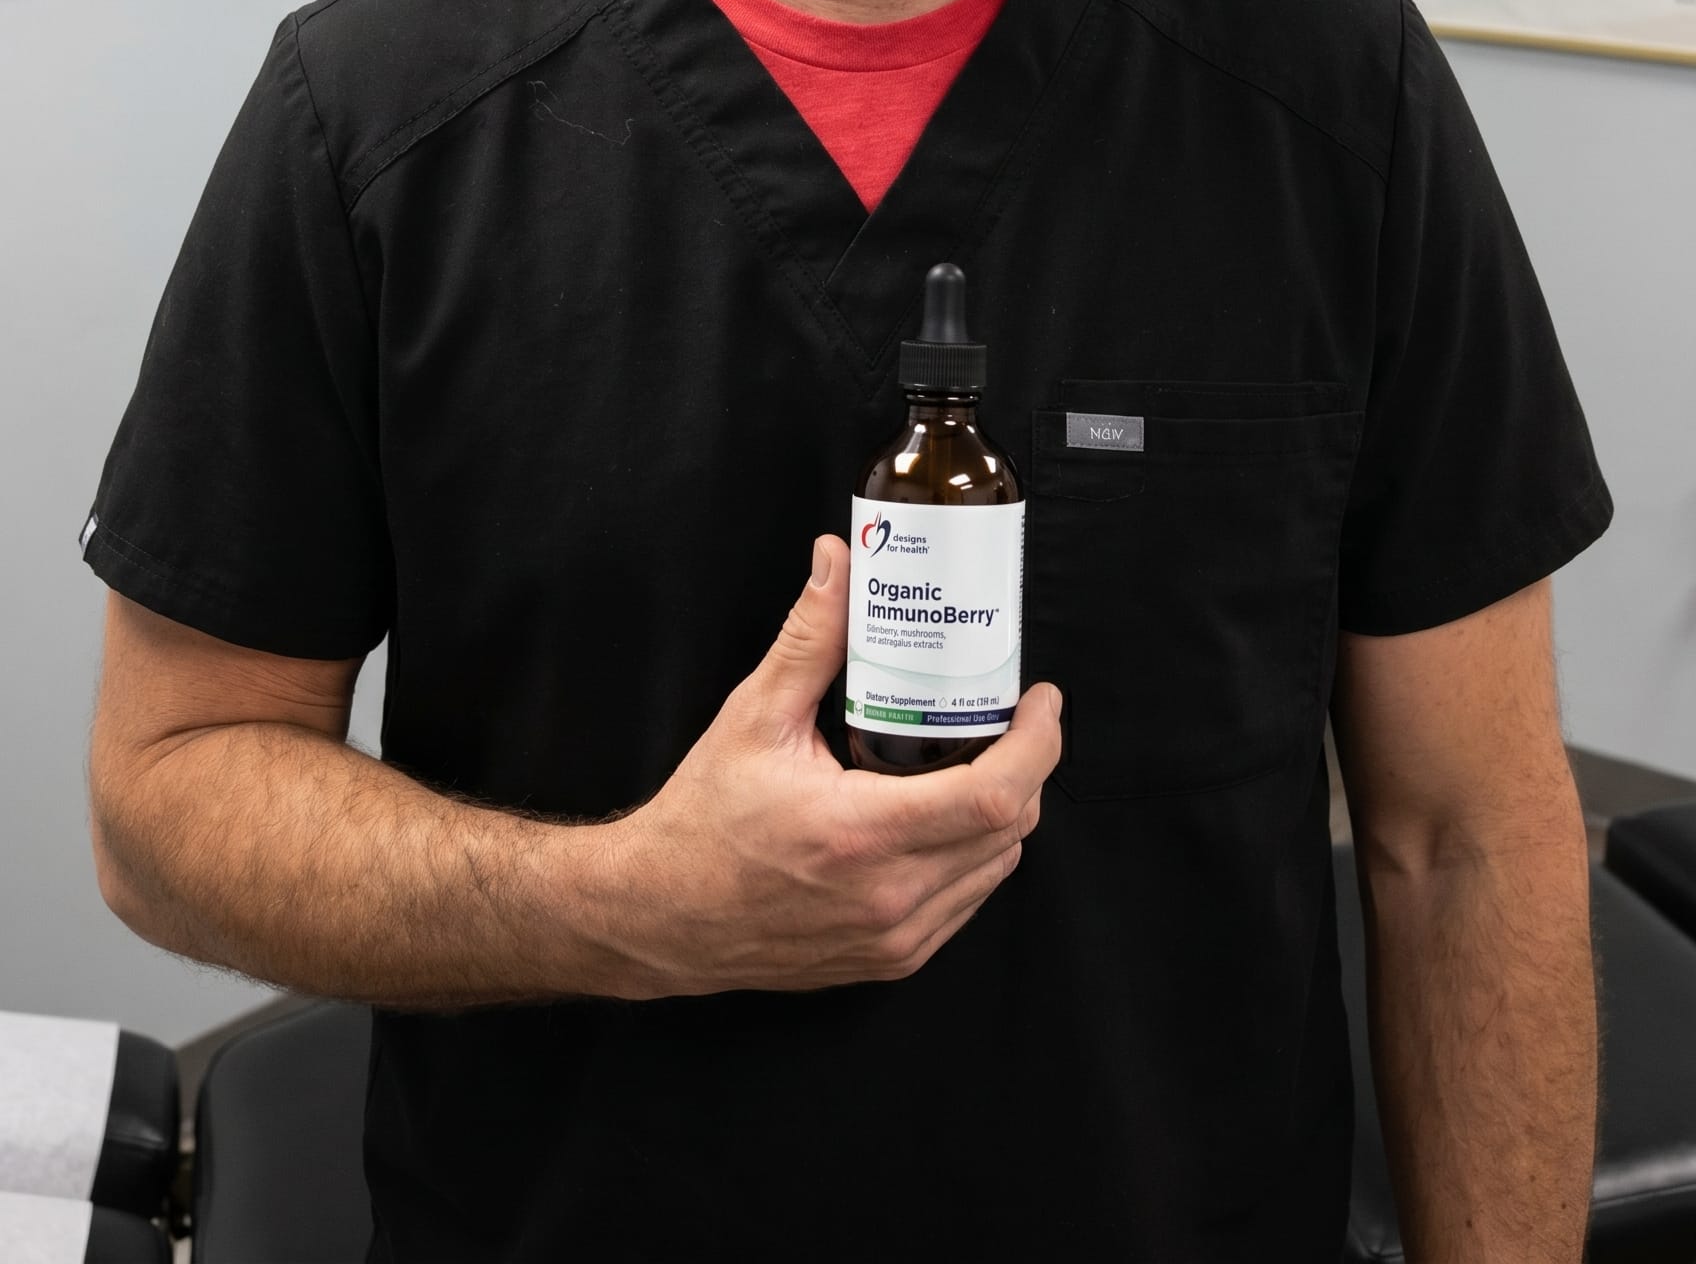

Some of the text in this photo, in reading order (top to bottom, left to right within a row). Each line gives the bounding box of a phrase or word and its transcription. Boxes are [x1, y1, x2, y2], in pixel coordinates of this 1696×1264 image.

[893, 534, 927, 545] designs
[887, 544, 929, 555] for health
[868, 578, 942, 601] Organic
[900, 629, 946, 640] mushrooms,
[914, 640, 943, 650] extracts
[890, 695, 936, 707] Supplement
[951, 697, 957, 706] 4
[959, 696, 965, 707] fl
[966, 699, 975, 707] oz
